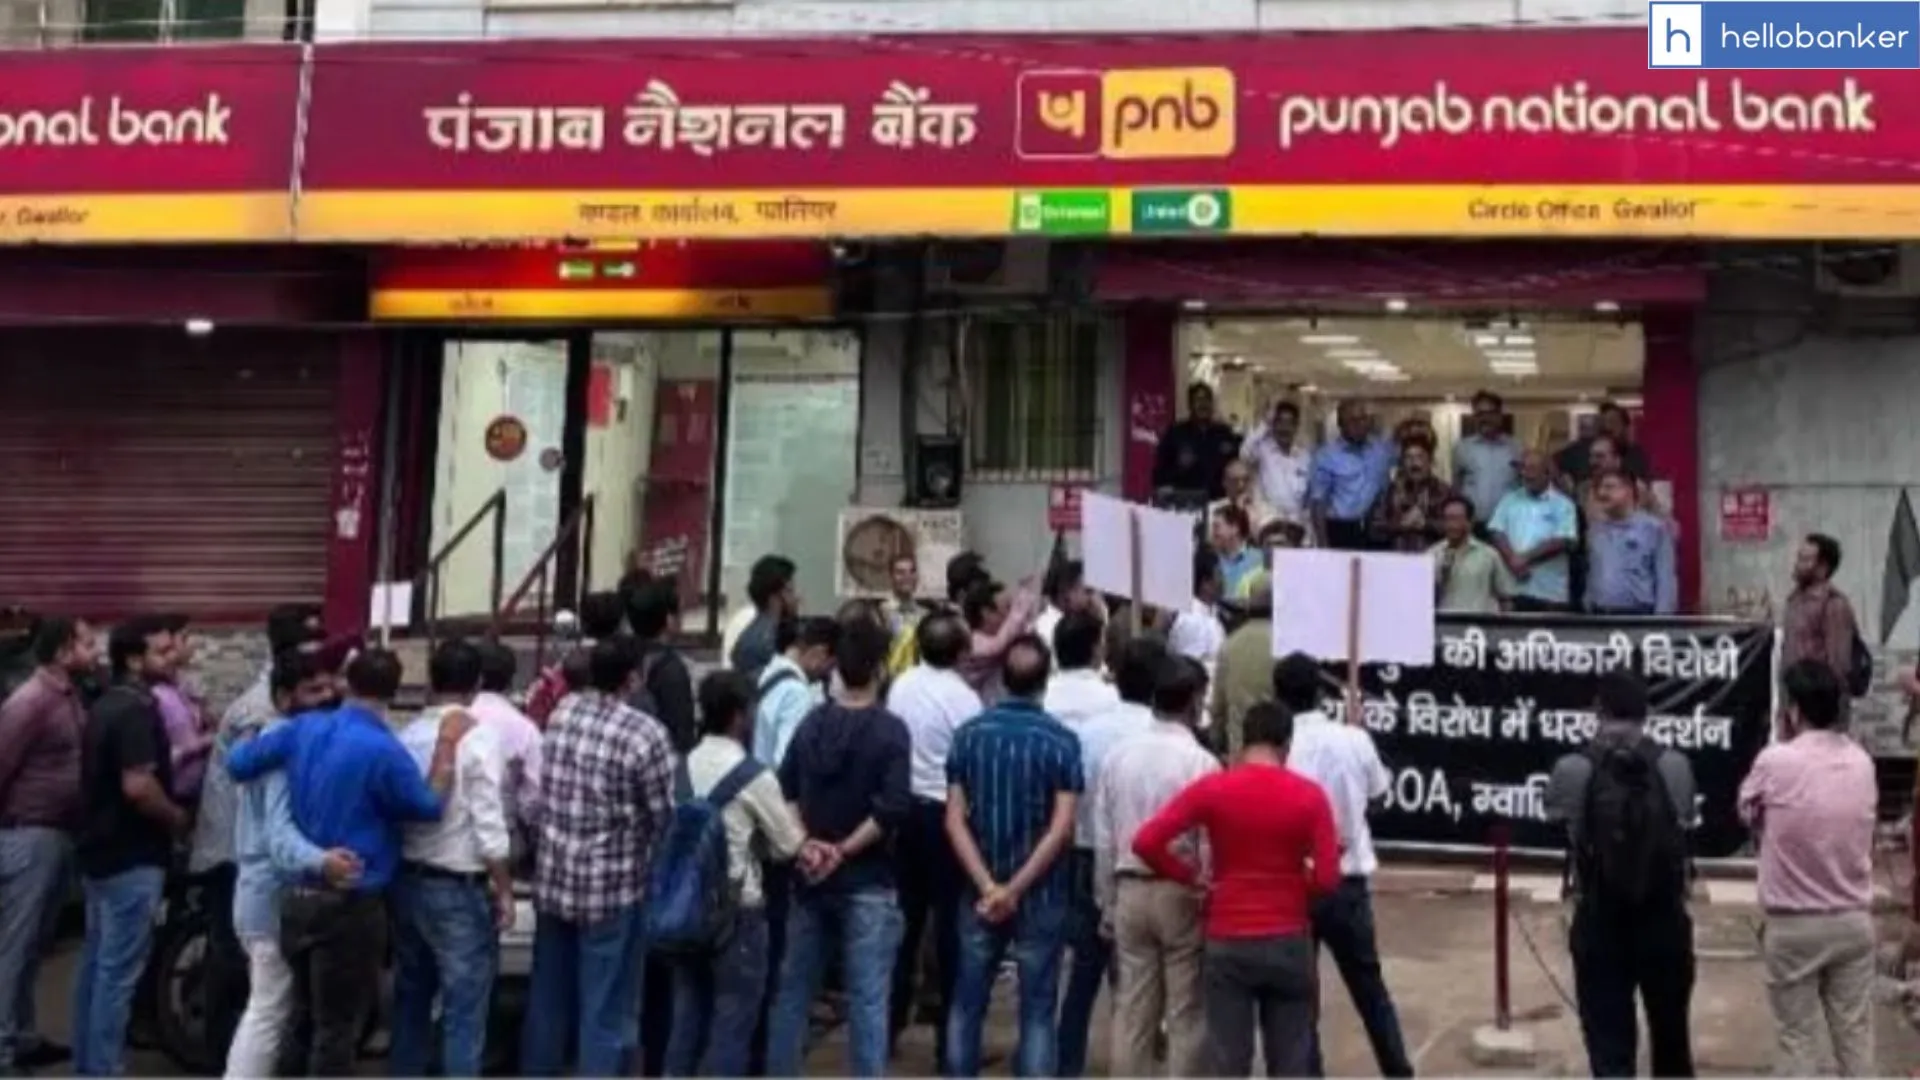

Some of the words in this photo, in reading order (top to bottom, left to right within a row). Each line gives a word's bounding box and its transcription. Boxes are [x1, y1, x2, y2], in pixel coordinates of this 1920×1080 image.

[108, 92, 232, 145] bank
[423, 93, 604, 152] पंजाब
[624, 80, 845, 155] नैशनल
[872, 80, 978, 149] बैंक
[1114, 80, 1220, 148] pnb
[1280, 80, 1474, 150] punjab
[1482, 80, 1718, 133] national
[1732, 77, 1876, 132] bank
[1441, 626, 1487, 671] की
[1494, 629, 1632, 675] अधिकारी
[1643, 632, 1739, 681] विरोधी
[1362, 690, 1399, 733] के
[1406, 691, 1494, 739] विरोध
[1501, 696, 1536, 741] में
